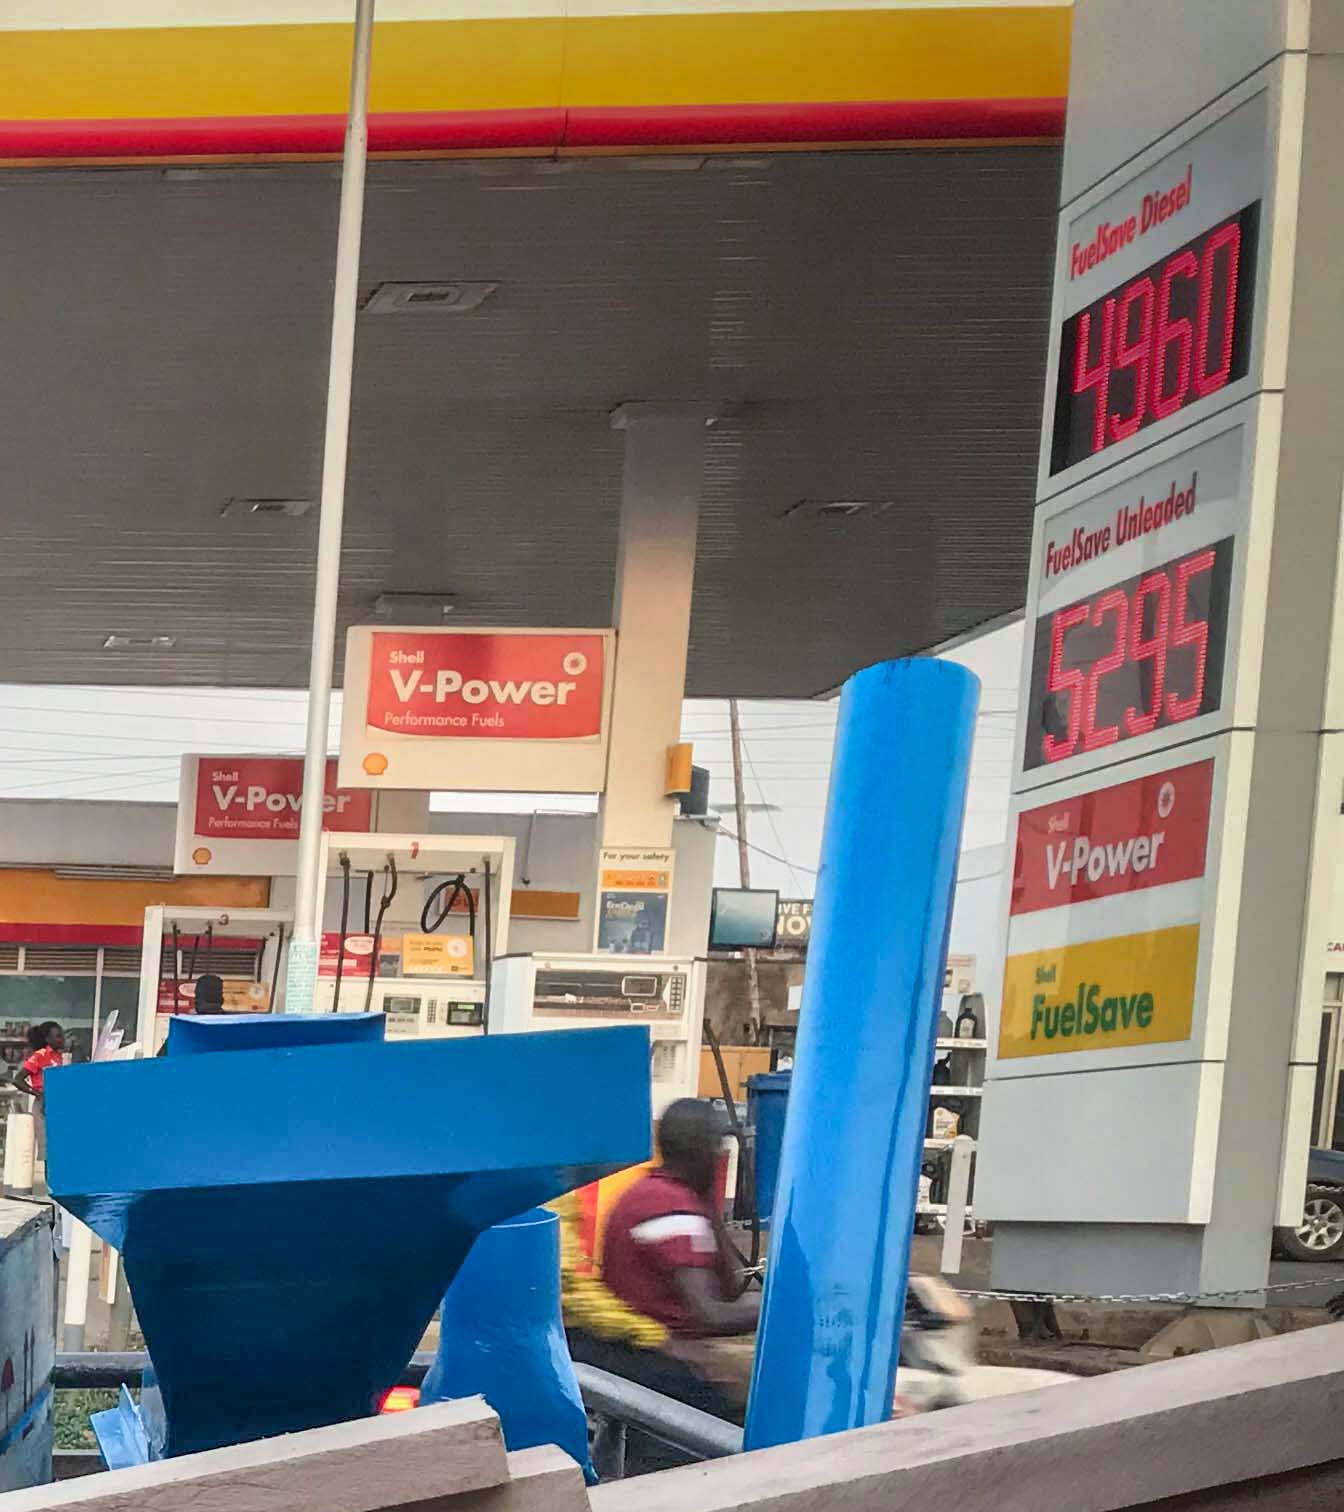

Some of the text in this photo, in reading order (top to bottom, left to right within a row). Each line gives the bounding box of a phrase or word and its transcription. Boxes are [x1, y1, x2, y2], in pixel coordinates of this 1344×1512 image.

[1070, 161, 1192, 281] FuelSave Diesel
[1073, 222, 1241, 453] 4960
[1046, 470, 1198, 578] FuelSave Unleaded
[389, 650, 425, 664] Shell
[1043, 550, 1217, 763] 5295
[389, 668, 577, 705] V-Power
[384, 709, 505, 727] Performance Fuels
[212, 771, 239, 782] Shell
[208, 815, 271, 829] Performance
[1046, 831, 1166, 890] V-Power
[1030, 982, 1154, 1040] FuelSave
